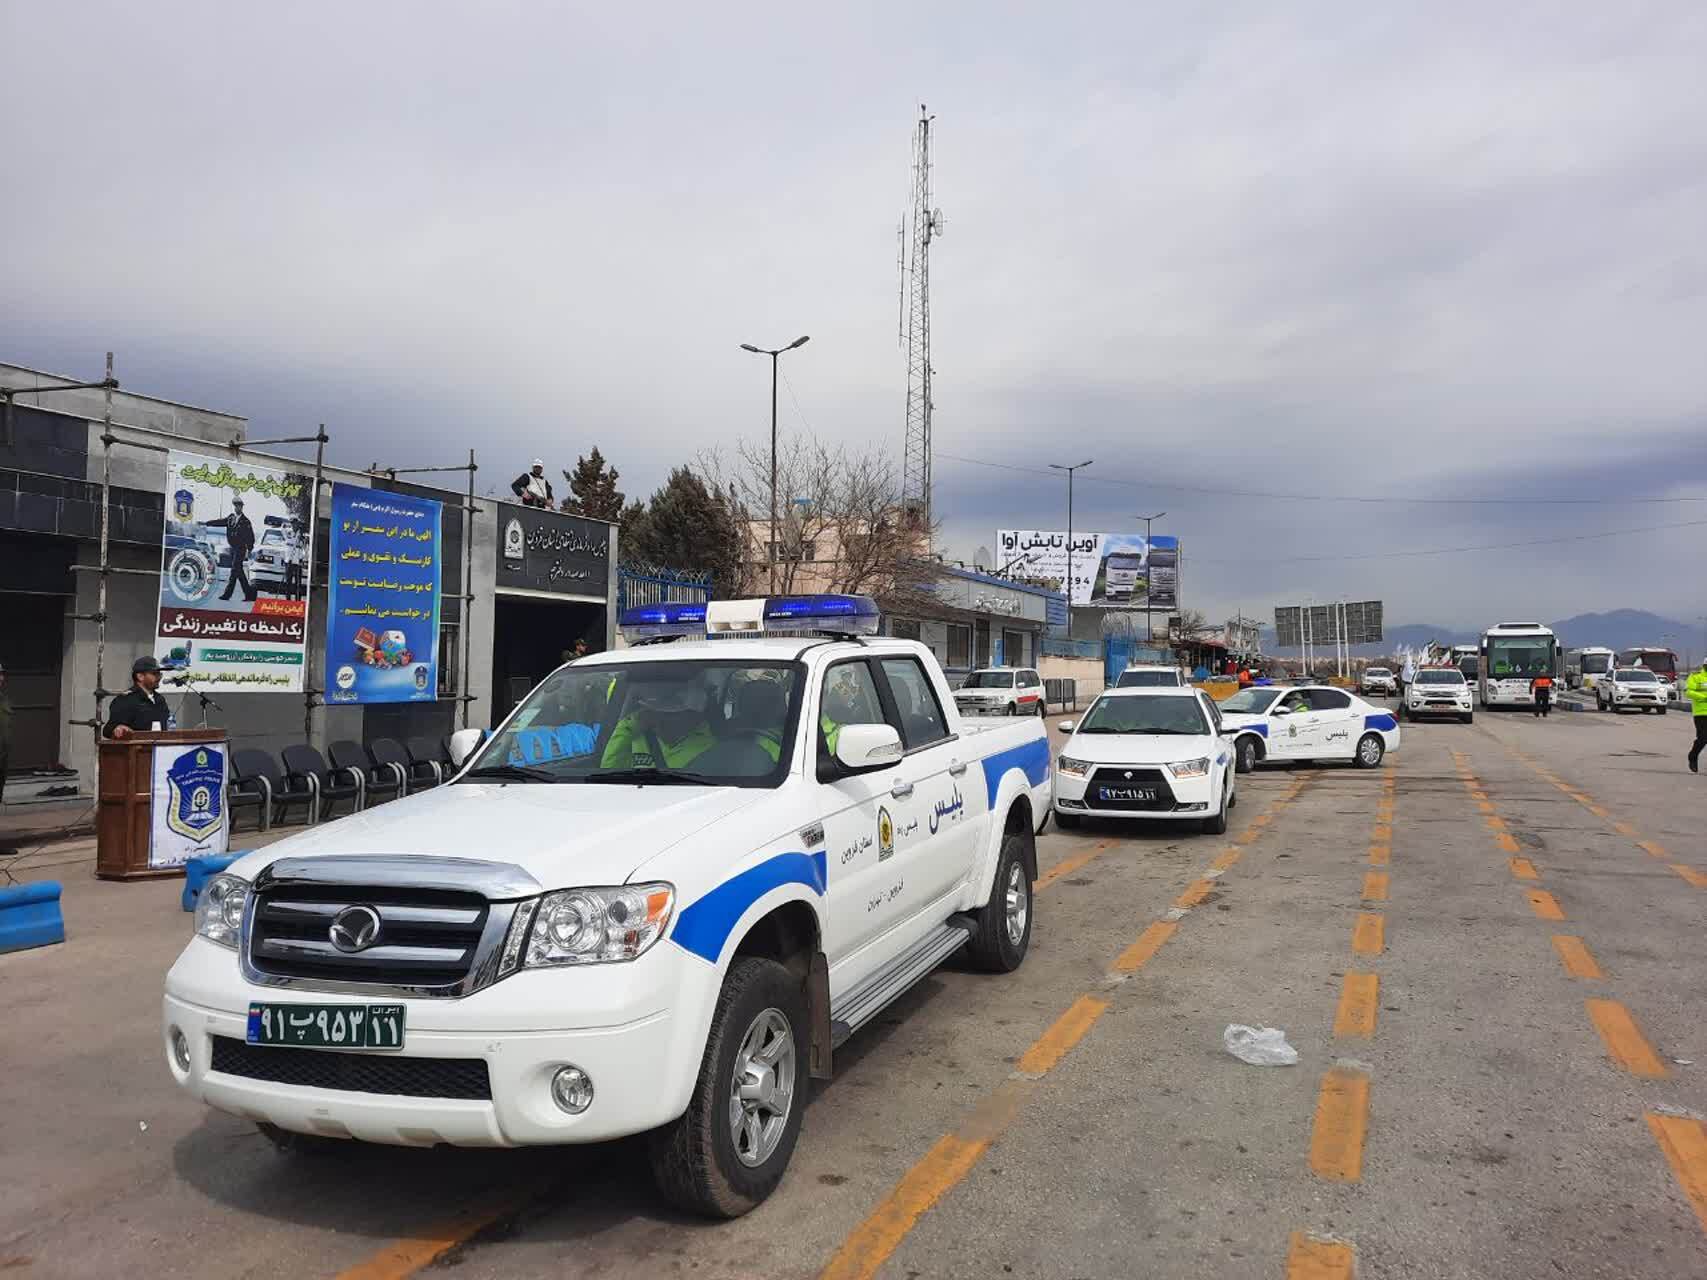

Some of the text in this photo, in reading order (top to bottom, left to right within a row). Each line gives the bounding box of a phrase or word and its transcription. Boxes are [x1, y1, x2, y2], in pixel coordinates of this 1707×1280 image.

[352, 520, 360, 533] از
[362, 525, 385, 534] سفر
[386, 526, 398, 537] این
[408, 528, 415, 537] ما
[399, 530, 408, 539] در
[415, 529, 432, 541] الهی
[527, 526, 544, 550] قزوین
[542, 528, 560, 549] استان
[1001, 531, 1098, 552] آوین تابش آوا
[341, 546, 361, 559] عملی
[368, 551, 392, 563] تقوی
[339, 577, 433, 594] که موجب رضایت توست
[260, 601, 304, 614] ایمن برانیم
[378, 610, 390, 618] می
[163, 612, 302, 640] یک لحظه تا تغییر زندگی
[235, 672, 266, 685] فرماندهی
[272, 674, 290, 686] پلیس
[1325, 729, 1349, 741] پلیس
[928, 783, 964, 835] پلیس
[903, 815, 919, 837] پلیس
[859, 832, 873, 854] استان
[840, 840, 860, 865] قزوین
[867, 875, 905, 912] قزوین تهران
[372, 1006, 400, 1015] ایران
[372, 1016, 398, 1045] ۱۱
